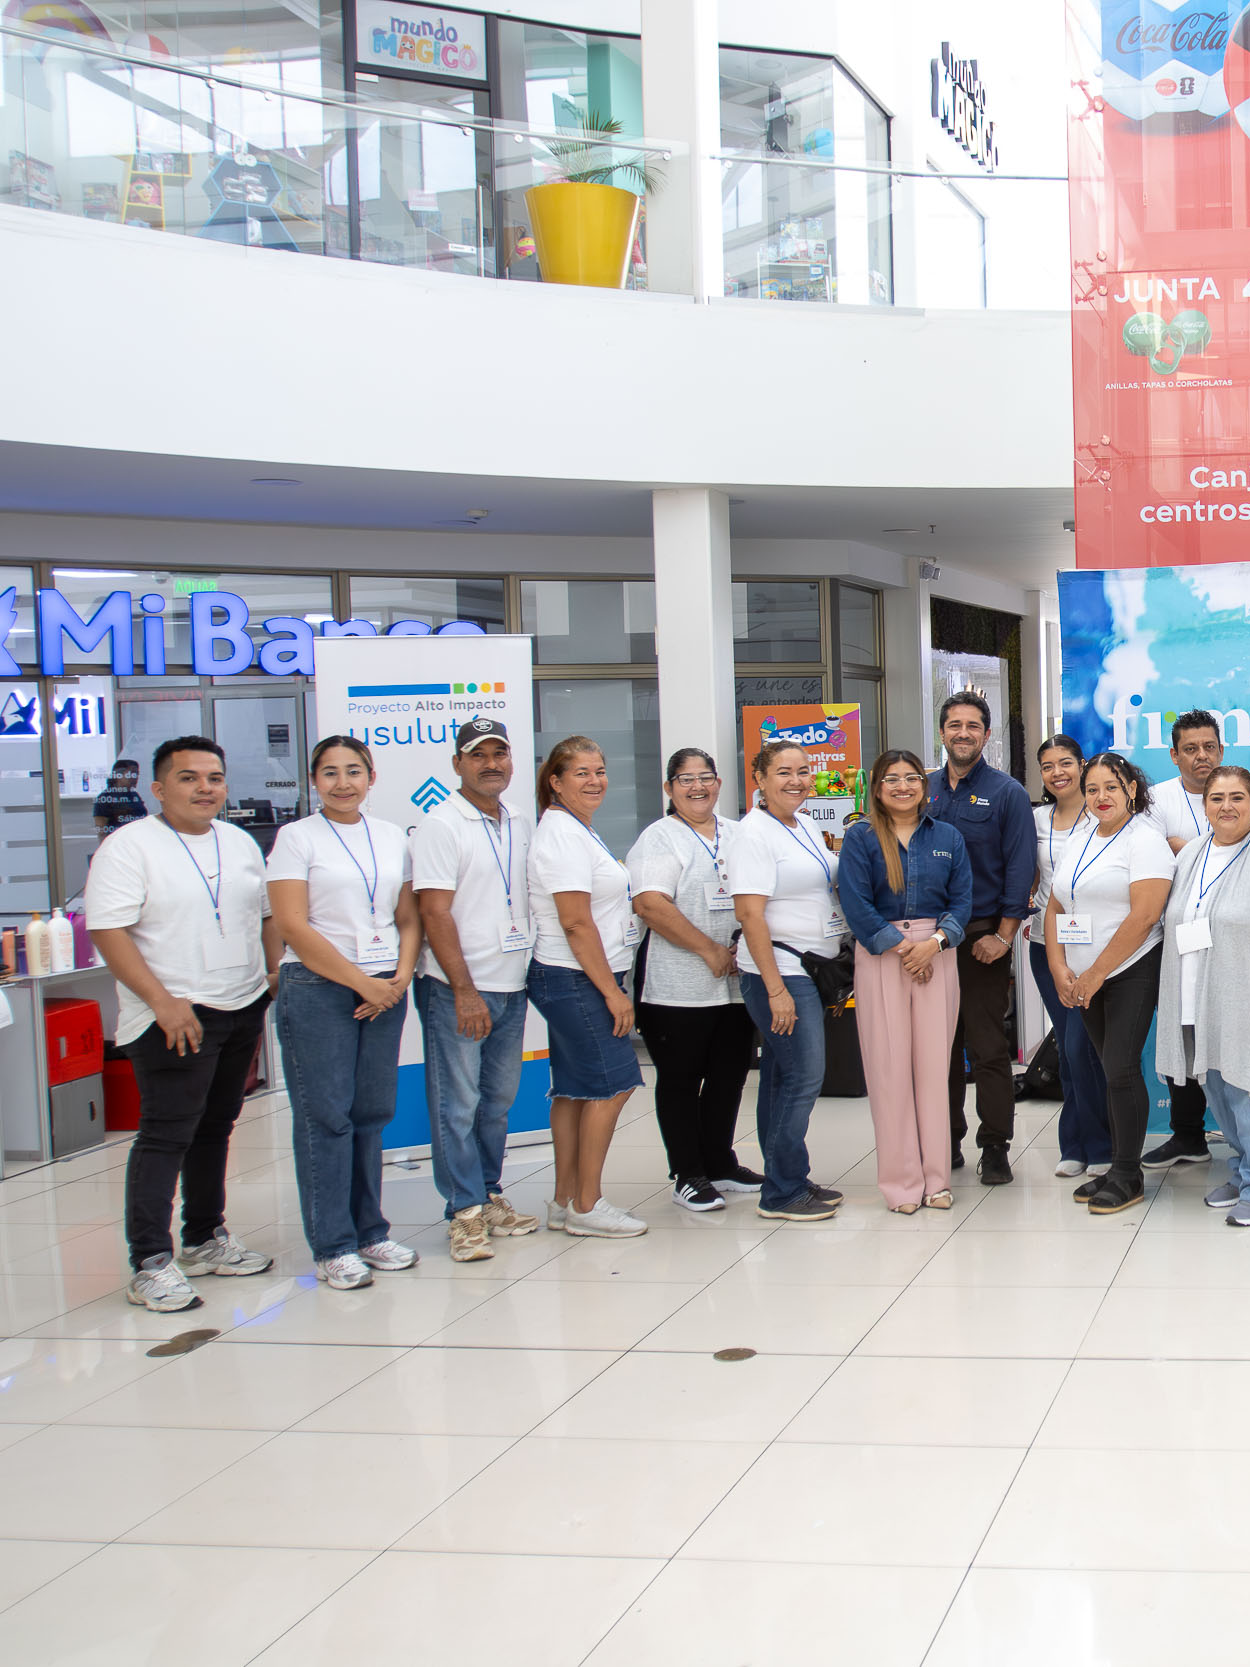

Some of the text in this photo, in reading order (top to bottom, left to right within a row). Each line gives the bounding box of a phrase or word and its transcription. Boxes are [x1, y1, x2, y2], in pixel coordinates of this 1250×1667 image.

[390, 17, 458, 43] mundo
[1116, 12, 1232, 54] Coca-Cola
[373, 29, 477, 71] MAGICO
[1113, 277, 1220, 303] JUNTA
[1105, 382, 1140, 390] ANILLAS,
[1142, 381, 1166, 389] TAPAS
[1176, 379, 1233, 388] CORCHOLATAS
[39, 588, 166, 676] Mi
[348, 699, 506, 714] Proyecto Alto Impacto
[349, 714, 507, 746] usulut
[812, 809, 836, 820] CLUB
